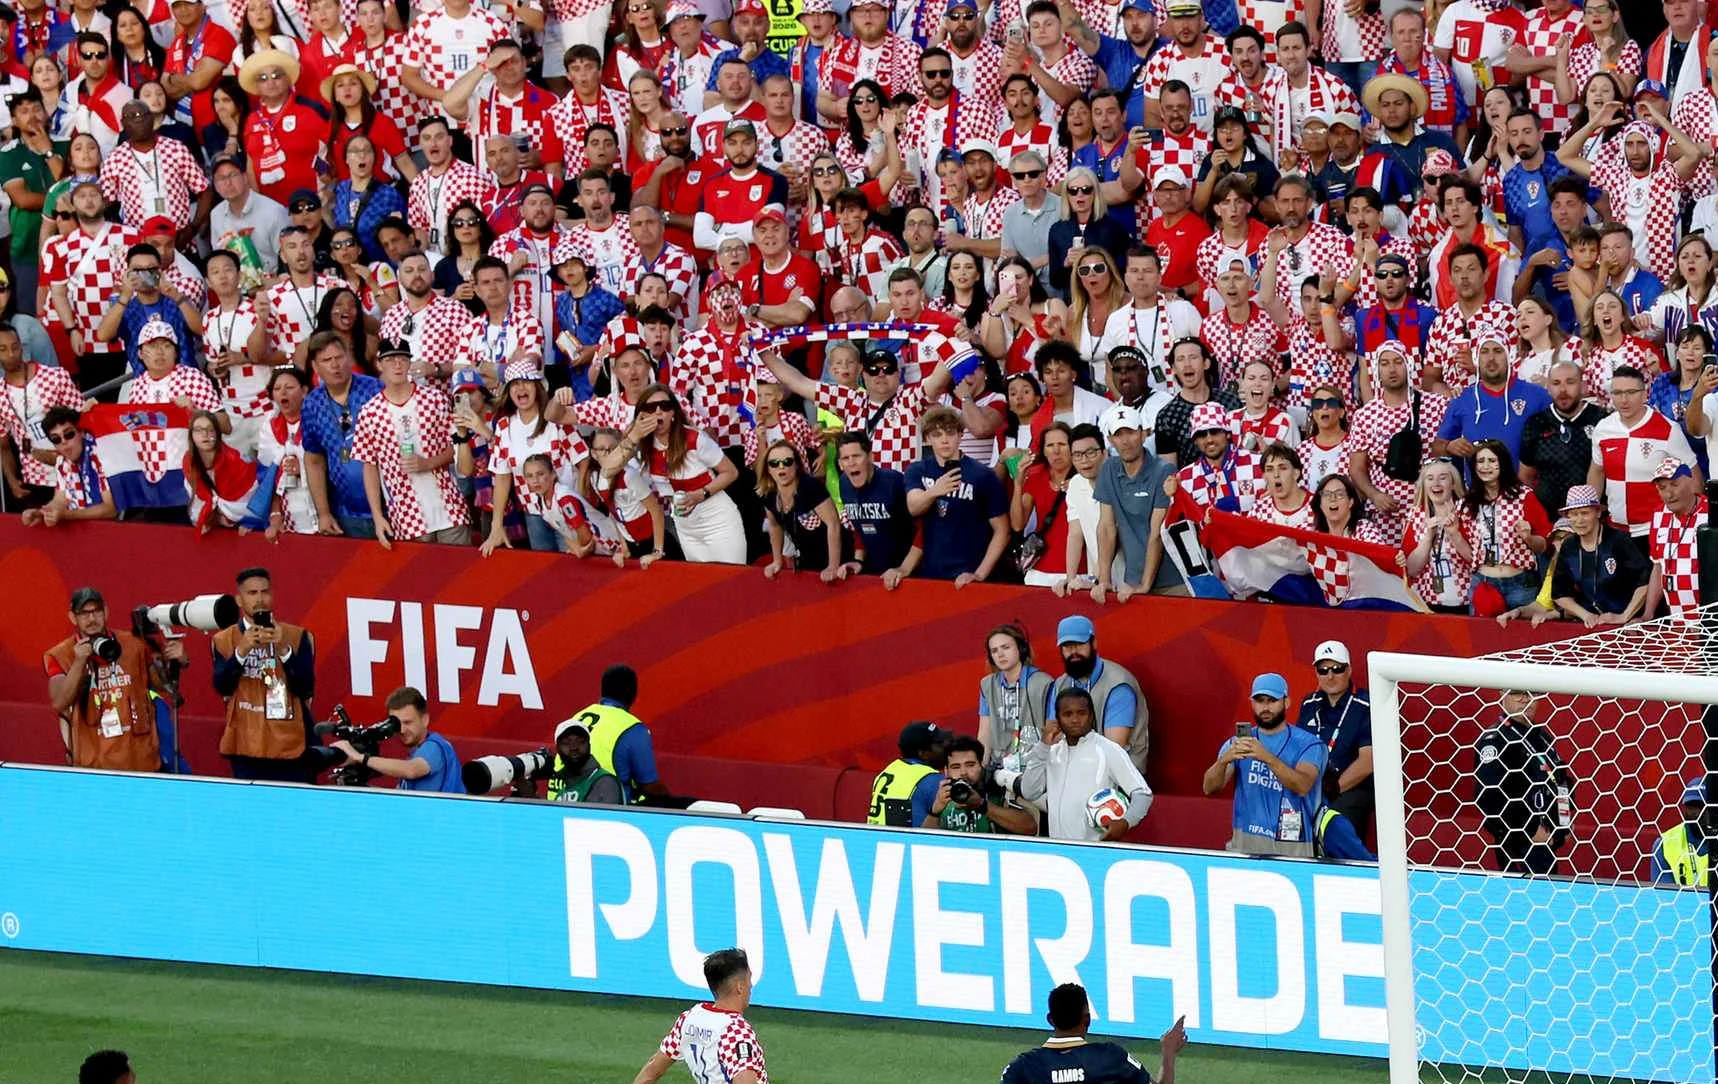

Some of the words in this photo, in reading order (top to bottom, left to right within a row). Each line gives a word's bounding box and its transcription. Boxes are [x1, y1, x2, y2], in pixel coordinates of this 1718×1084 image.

[452, 54, 468, 70] 10
[346, 597, 545, 711] FIFA
[562, 816, 1390, 1044] POWERADE
[1051, 1068, 1085, 1084] RAMOS
